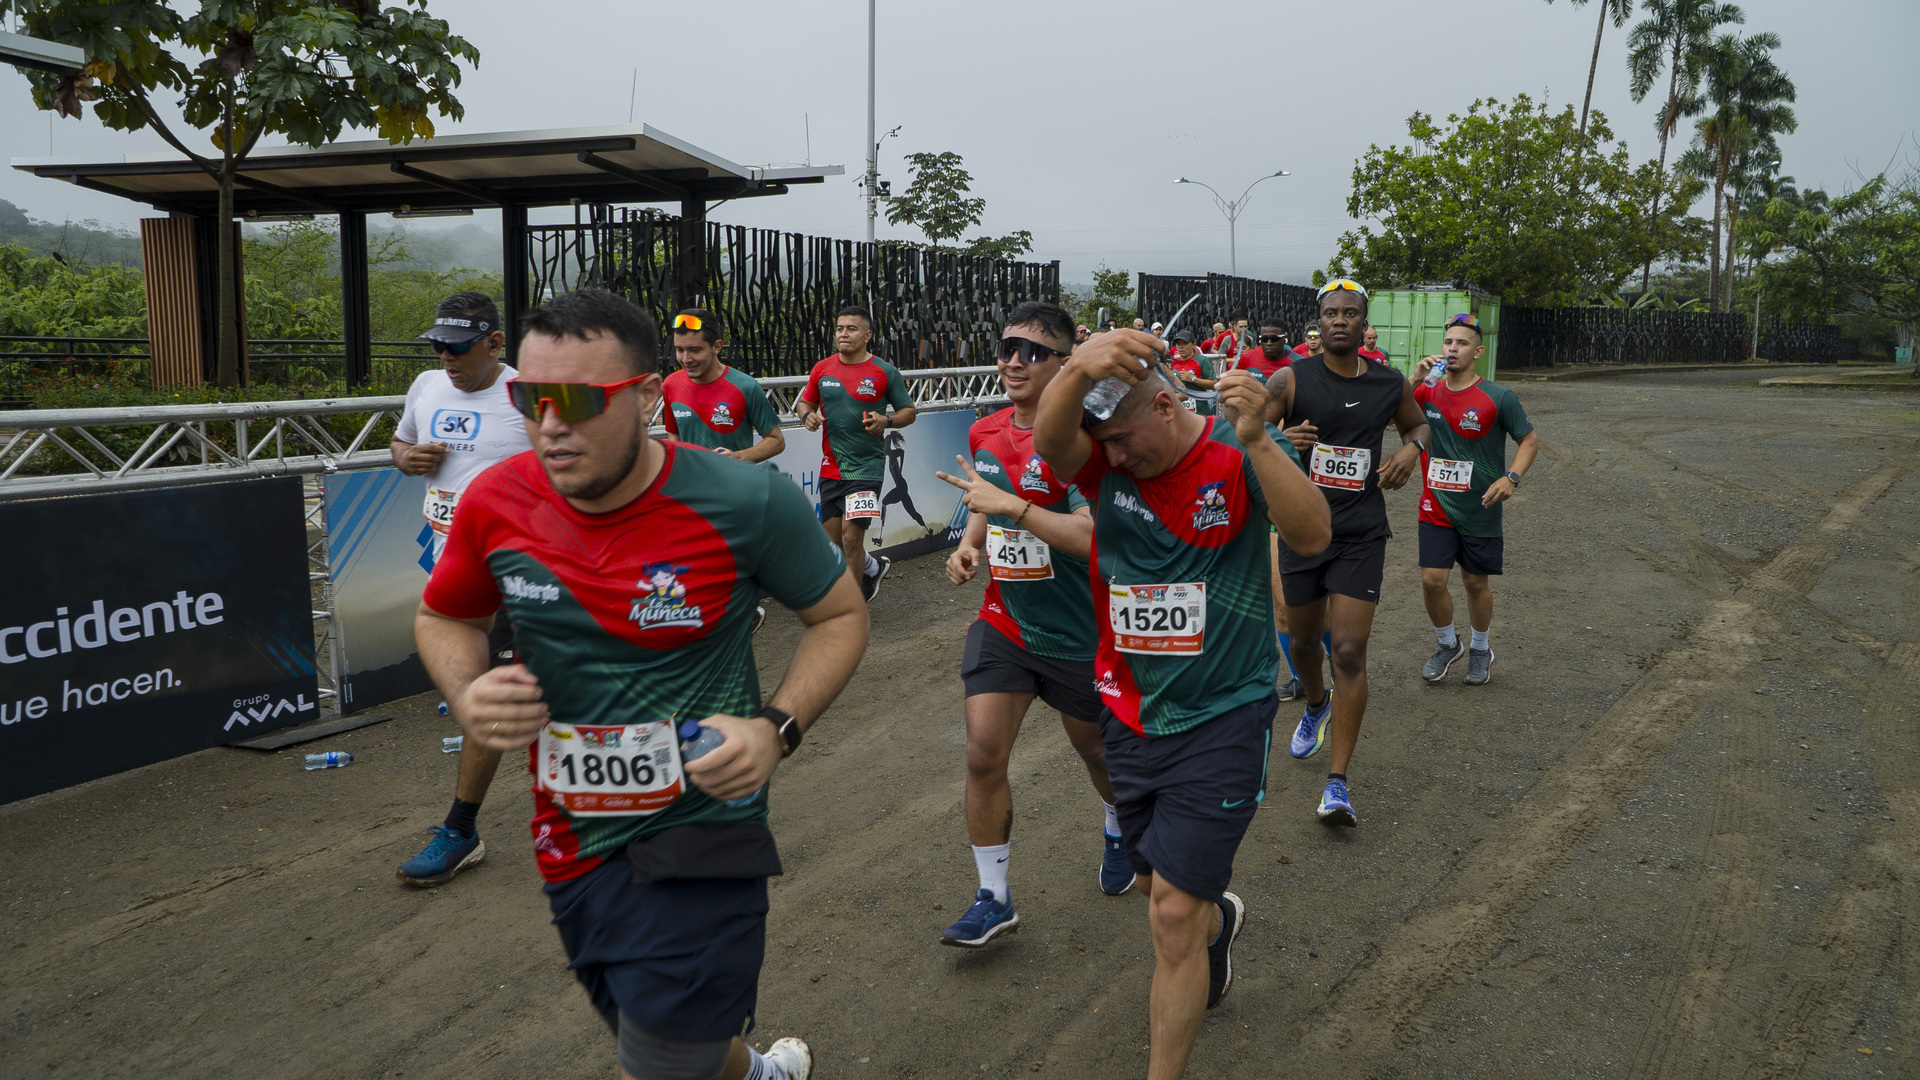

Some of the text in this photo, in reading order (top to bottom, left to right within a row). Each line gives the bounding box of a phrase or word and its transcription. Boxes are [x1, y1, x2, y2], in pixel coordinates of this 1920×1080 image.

[1325, 459, 1358, 477] 965
[1439, 469, 1459, 482] 571
[854, 500, 874, 510] 236
[997, 545, 1028, 565] 451
[649, 597, 663, 608] La
[628, 603, 702, 627] Muñeca
[1119, 606, 1187, 631] 1520
[0, 590, 224, 664] ccidente
[0, 668, 182, 726] ue hacen.
[233, 694, 270, 708] Grupo
[223, 694, 314, 731] AVAL
[561, 753, 655, 786] 1806
